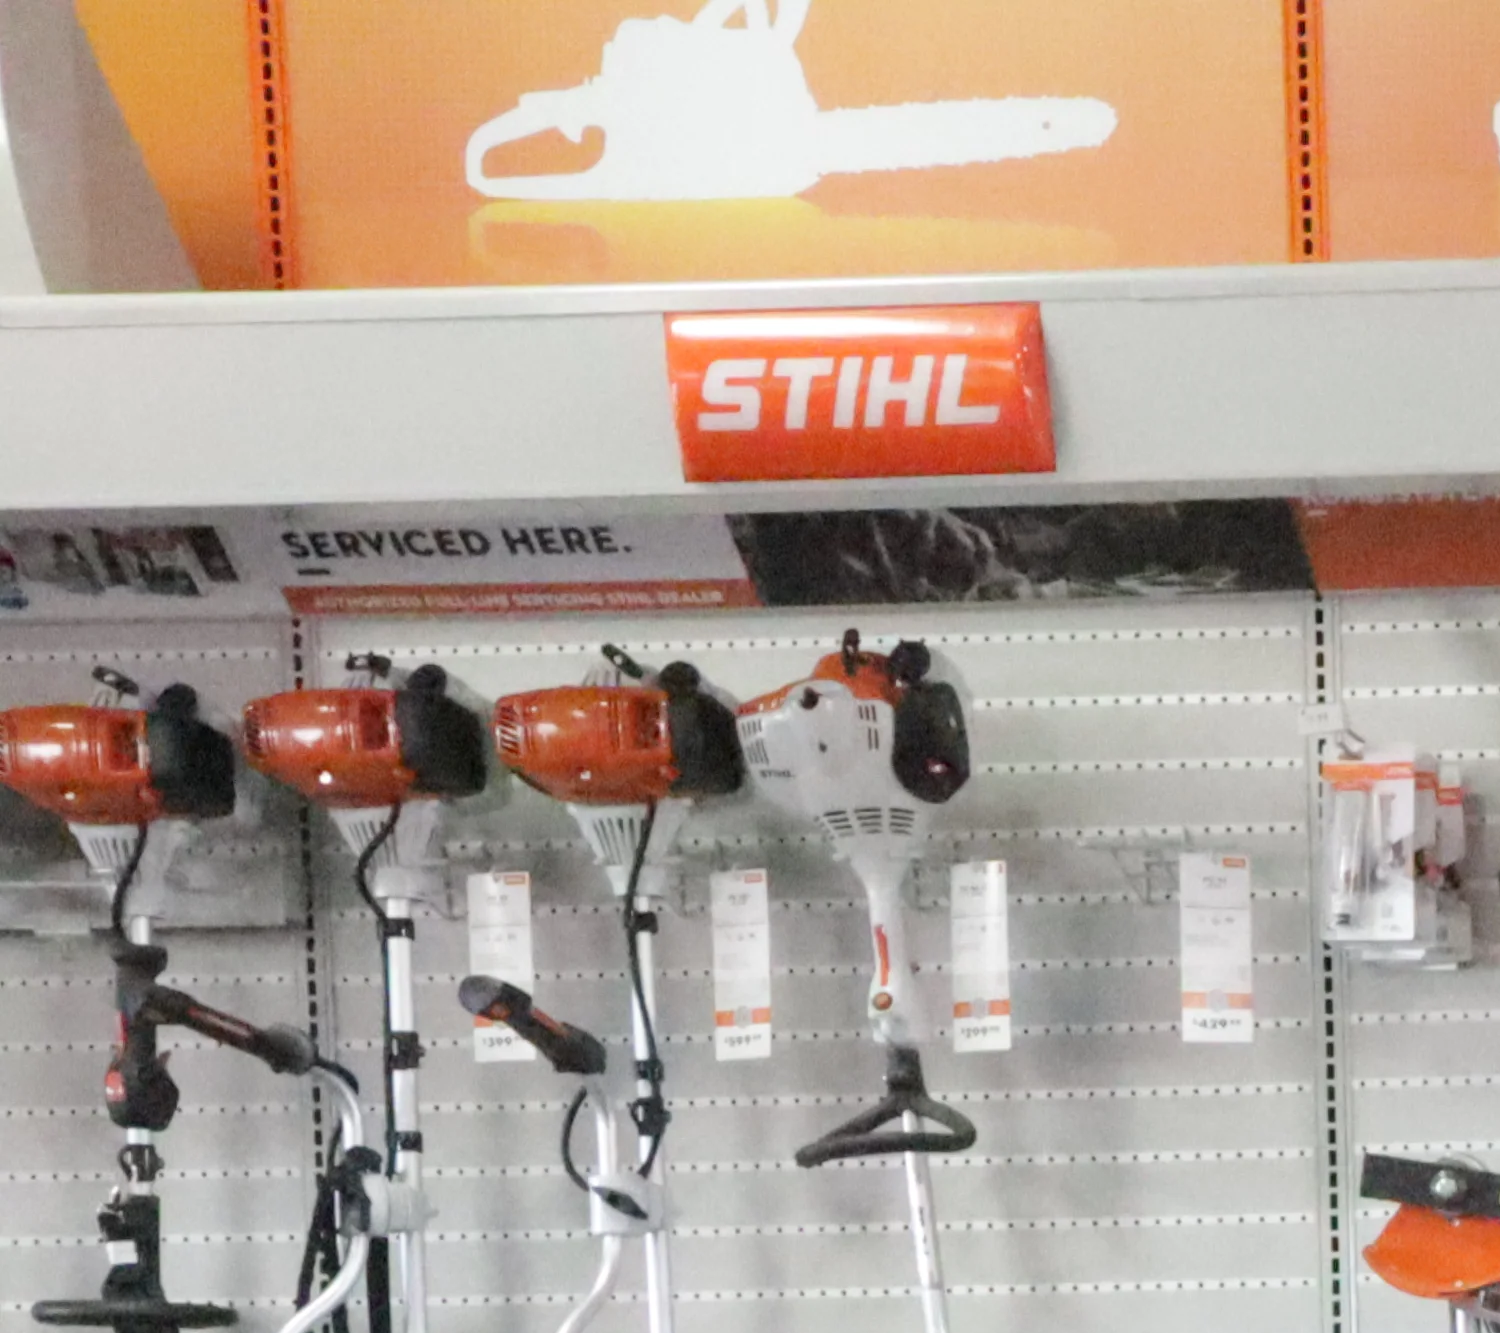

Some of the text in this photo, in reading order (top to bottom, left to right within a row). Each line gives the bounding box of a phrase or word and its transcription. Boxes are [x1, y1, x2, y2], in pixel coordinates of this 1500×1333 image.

[696, 353, 1001, 431] STIHL
[281, 526, 633, 560] SERVICED HERE.
